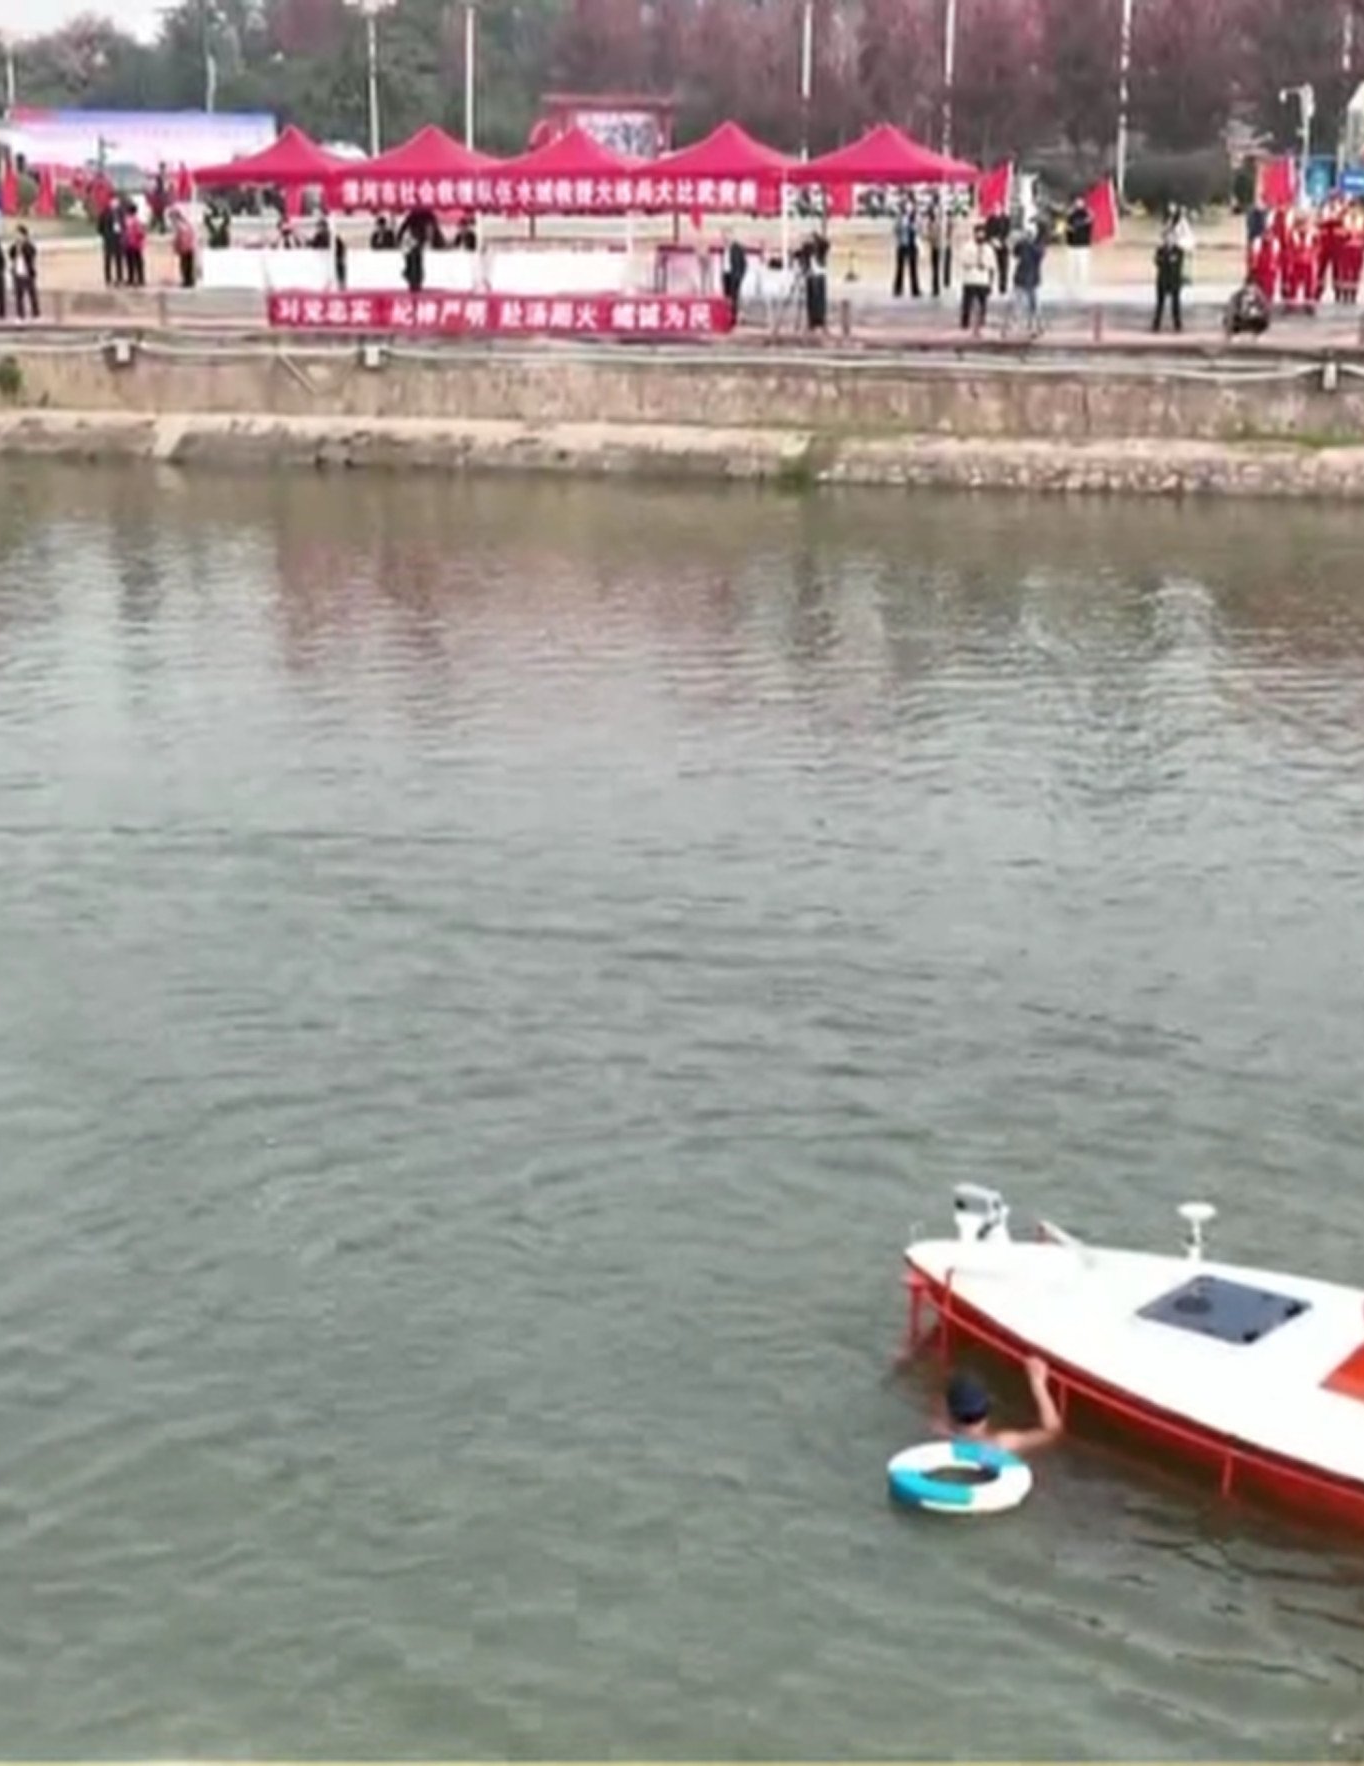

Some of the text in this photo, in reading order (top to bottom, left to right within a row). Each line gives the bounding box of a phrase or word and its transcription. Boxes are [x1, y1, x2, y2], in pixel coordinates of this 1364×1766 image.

[391, 299, 486, 328] 纪律严明
[501, 300, 598, 329] 赴汤蹈火
